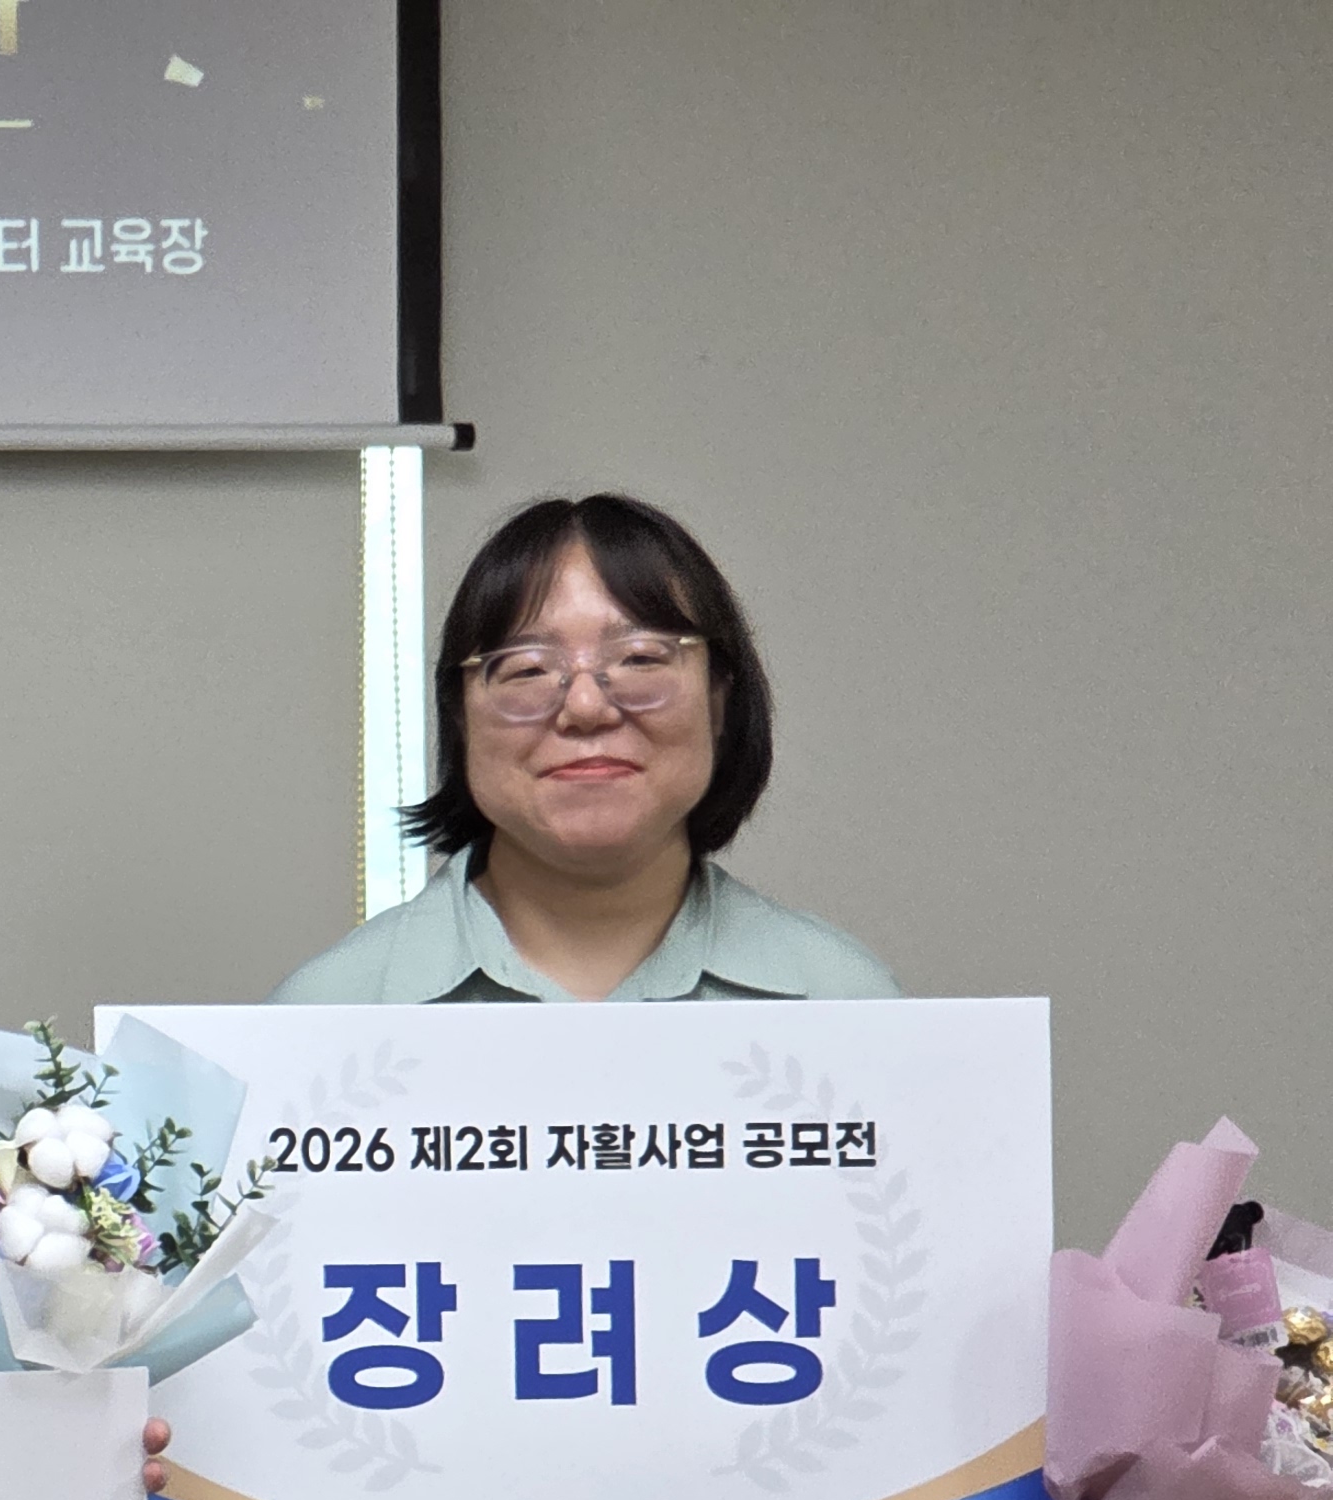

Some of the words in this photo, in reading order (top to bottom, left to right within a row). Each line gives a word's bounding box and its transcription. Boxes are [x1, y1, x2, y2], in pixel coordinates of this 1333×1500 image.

[59, 217, 209, 275] 교육장
[269, 1127, 395, 1172] 2026
[411, 1125, 529, 1171] 제2회
[548, 1123, 725, 1170] 자활사업
[743, 1121, 877, 1168] 공모전
